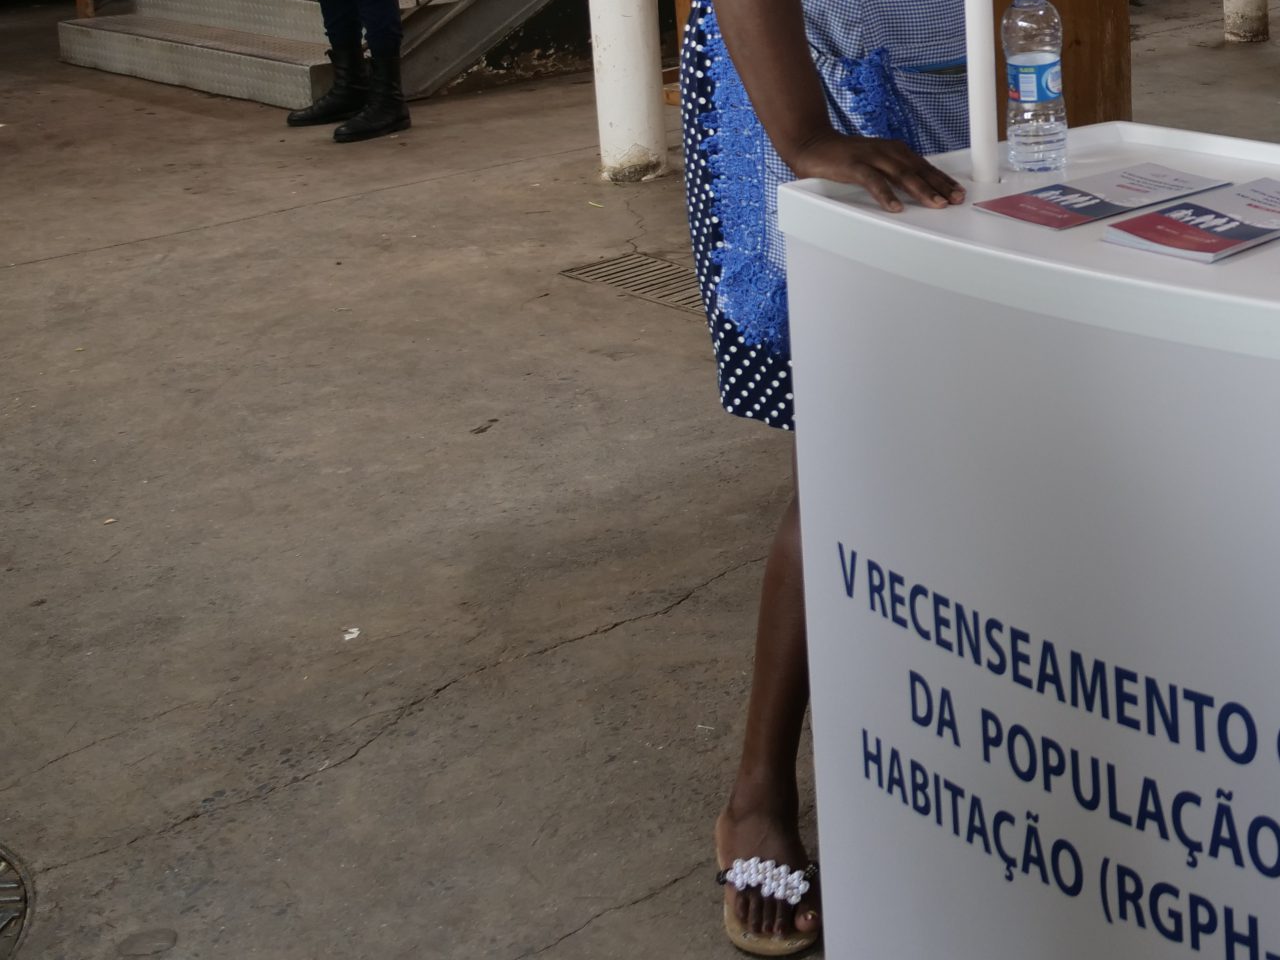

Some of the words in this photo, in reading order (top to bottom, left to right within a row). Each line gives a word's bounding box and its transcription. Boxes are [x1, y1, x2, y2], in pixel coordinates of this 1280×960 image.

[838, 541, 857, 598] V
[867, 558, 1258, 765] RECENSEAMENTO
[909, 669, 961, 748] DA
[862, 728, 1084, 897] HABITAÇÃO
